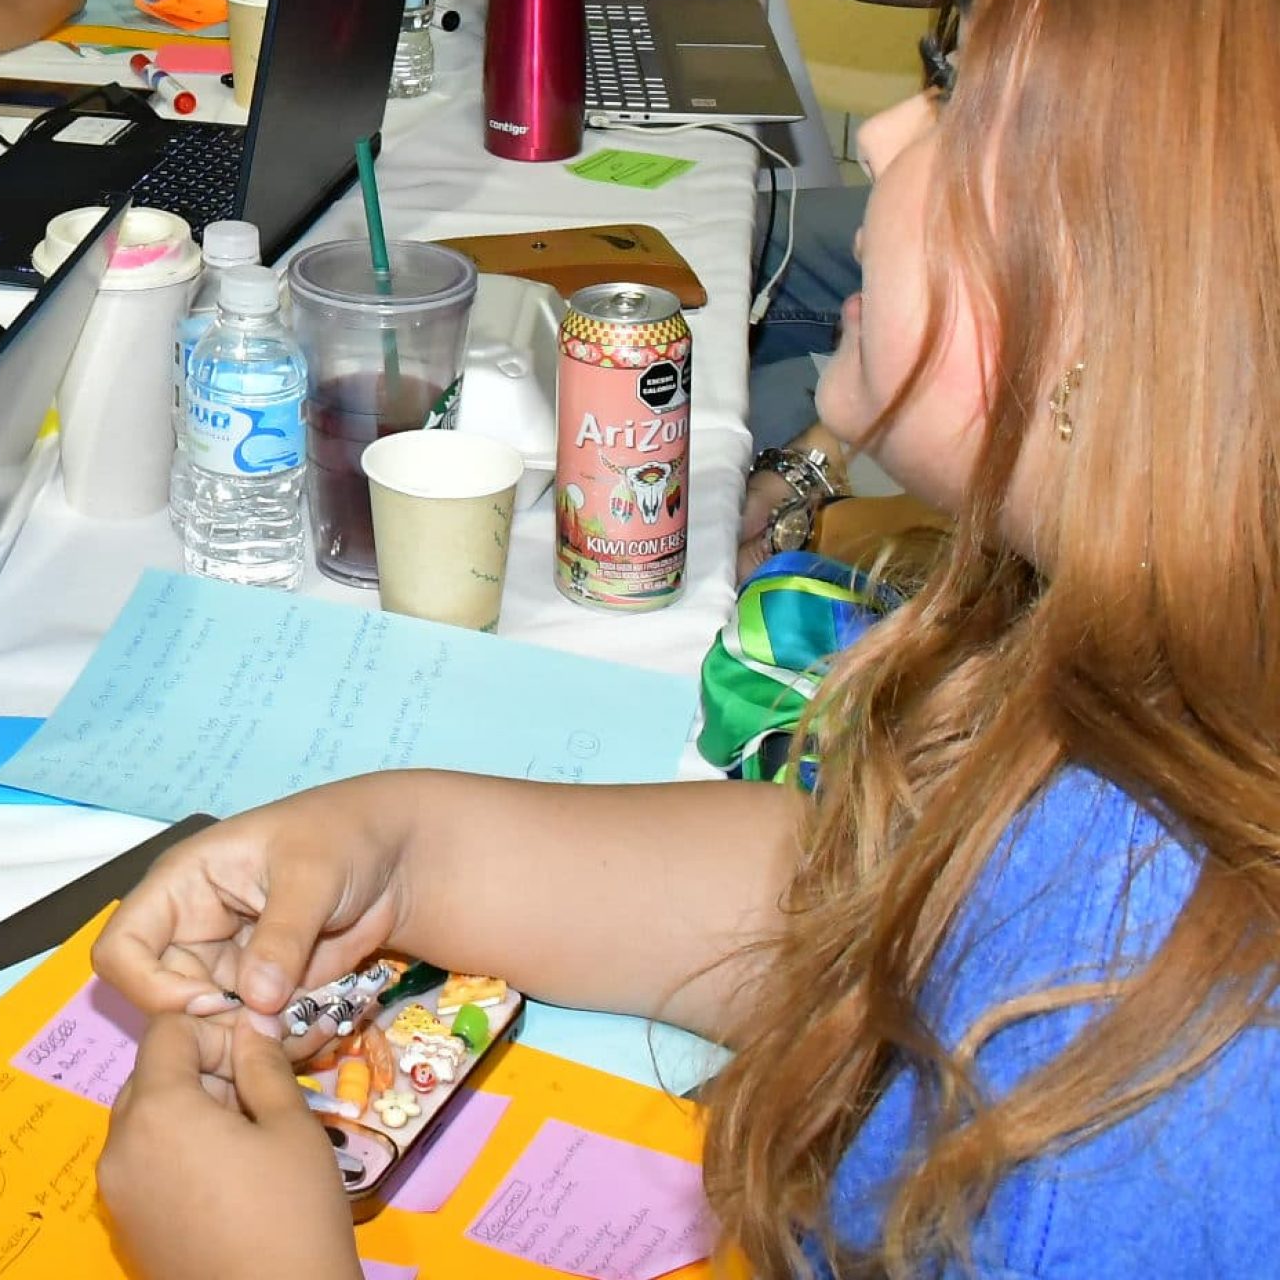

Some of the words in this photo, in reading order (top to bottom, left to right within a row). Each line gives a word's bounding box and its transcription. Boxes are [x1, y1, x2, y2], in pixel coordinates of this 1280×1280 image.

[488, 118, 530, 136] contigo
[586, 535, 625, 556] KIWI
[628, 538, 659, 556] CON
